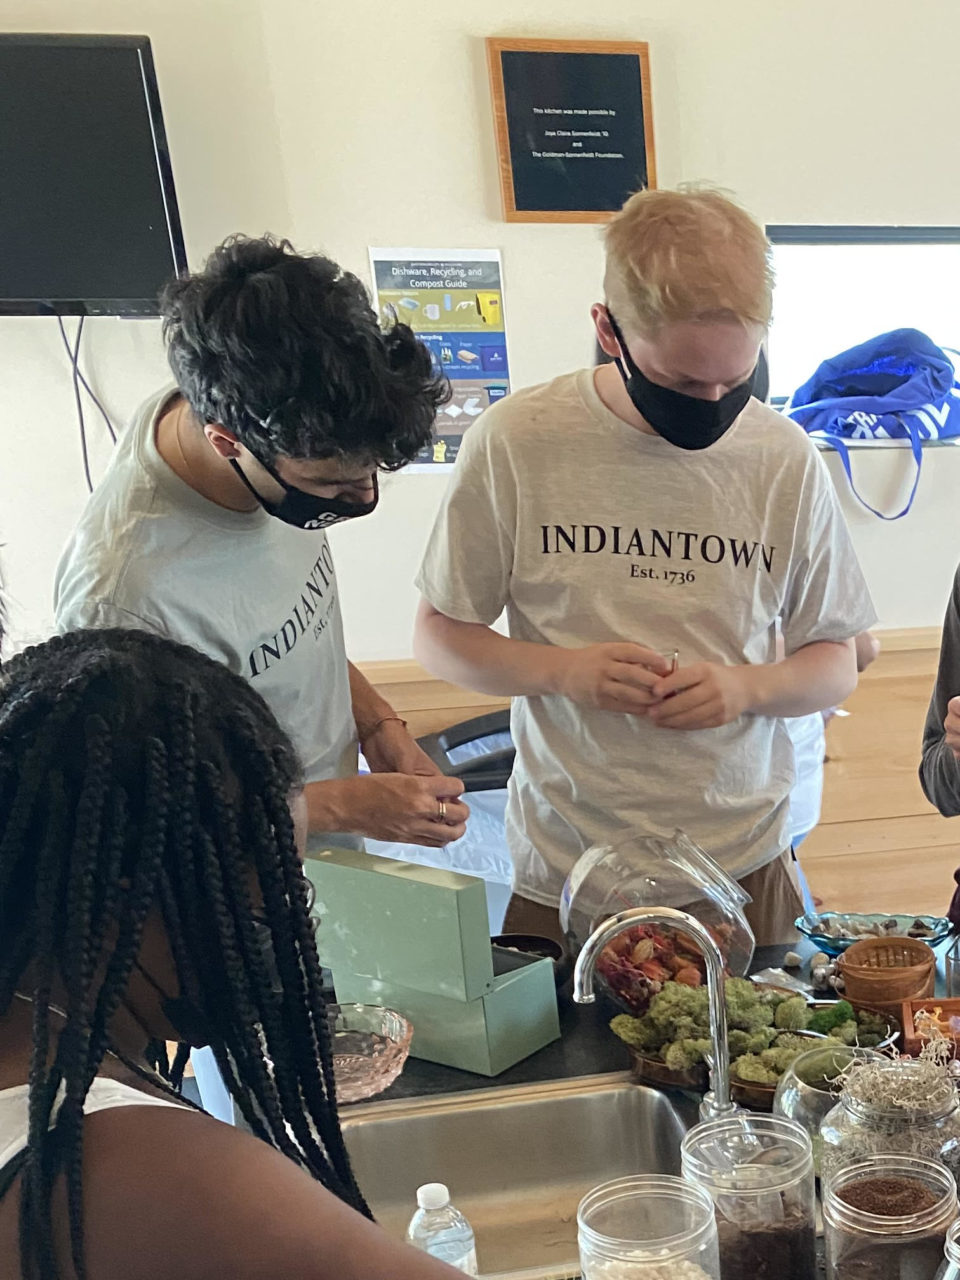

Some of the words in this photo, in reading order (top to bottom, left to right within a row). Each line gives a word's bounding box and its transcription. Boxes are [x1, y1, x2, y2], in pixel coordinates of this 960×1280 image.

[391, 267, 429, 276] Dishware,
[430, 267, 467, 278] Recycling,
[467, 267, 482, 276] and
[409, 279, 444, 289] Compost
[444, 279, 468, 288] Guide
[539, 524, 777, 574] INDIANTOWN
[630, 563, 659, 580] Est.
[664, 569, 696, 585] 1736
[249, 538, 335, 678] INDIANTO
